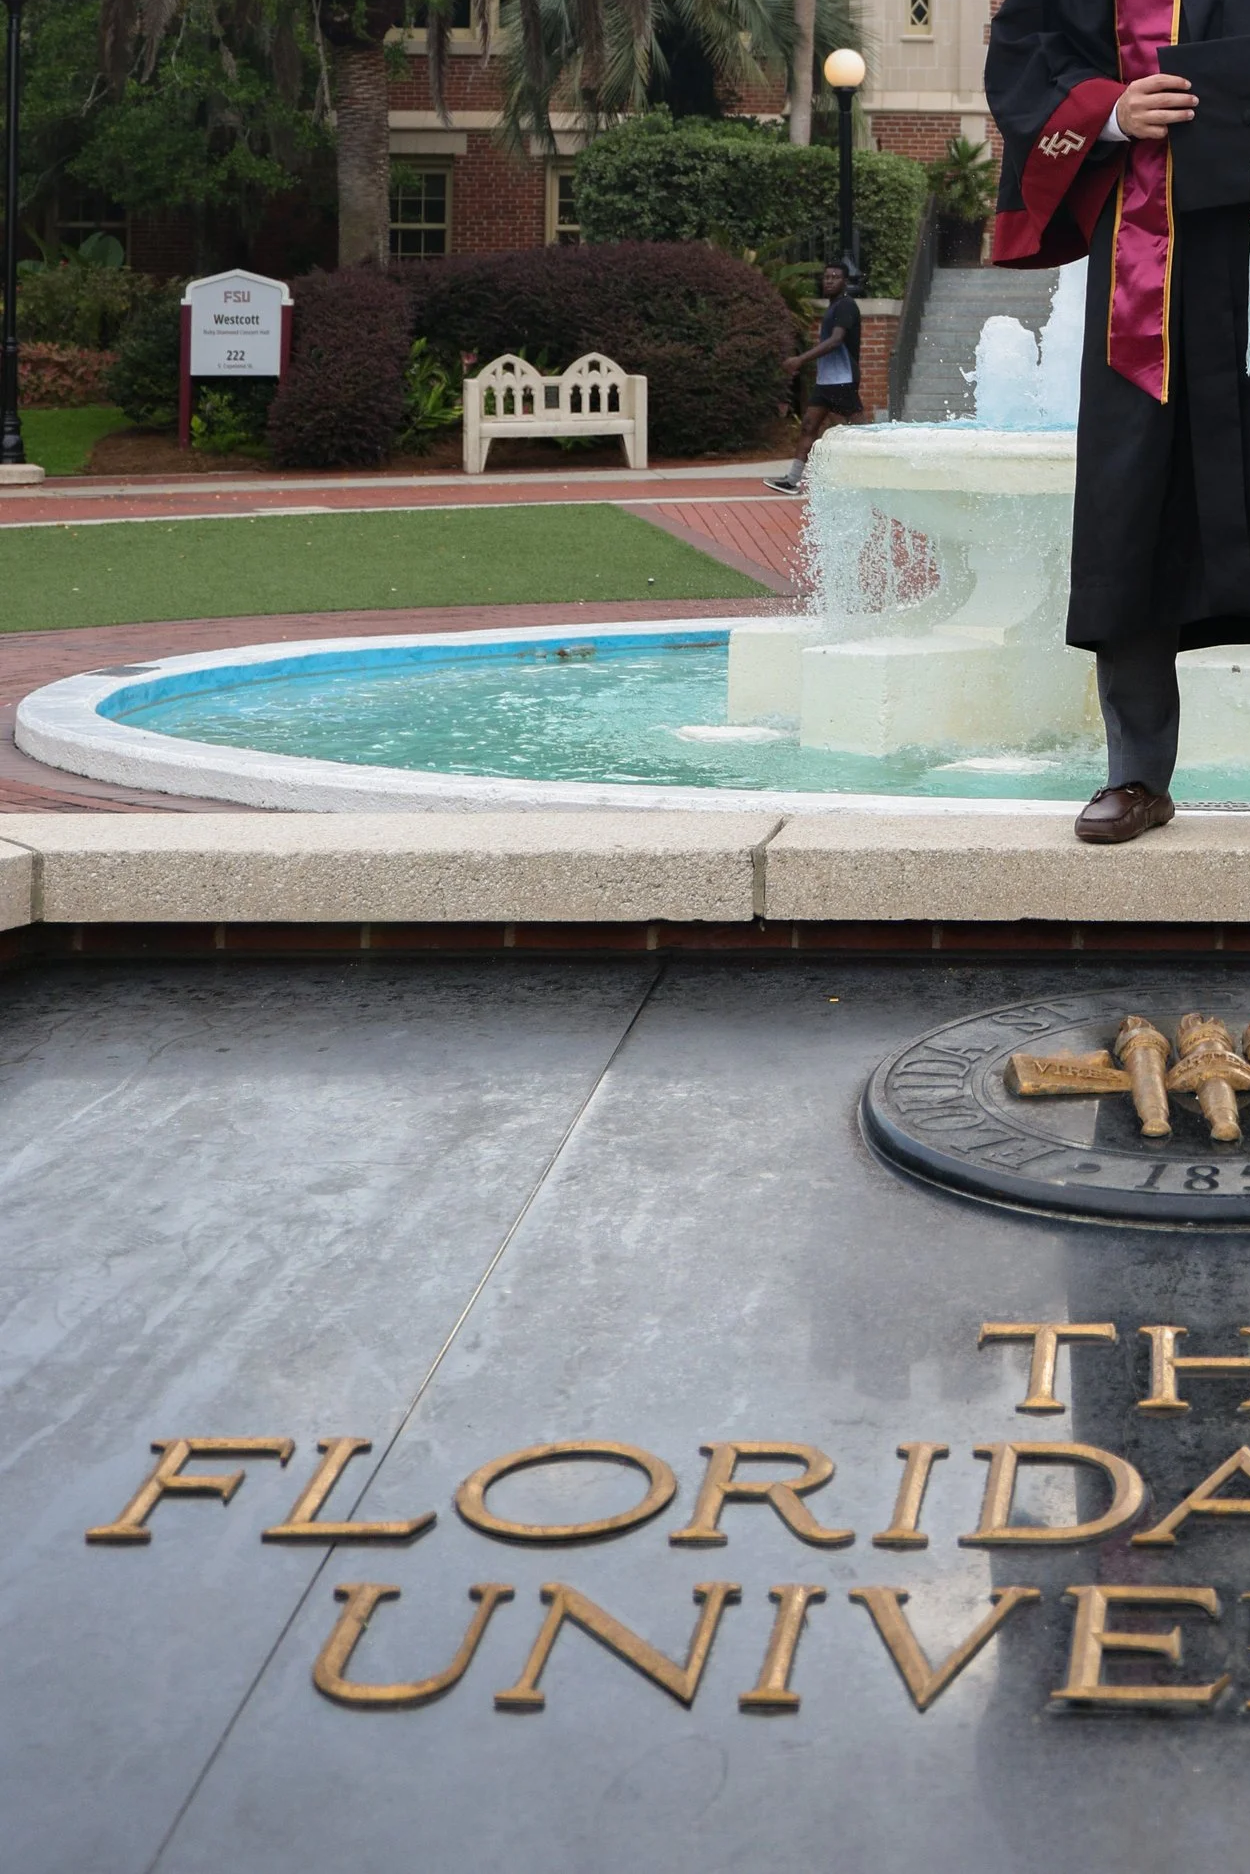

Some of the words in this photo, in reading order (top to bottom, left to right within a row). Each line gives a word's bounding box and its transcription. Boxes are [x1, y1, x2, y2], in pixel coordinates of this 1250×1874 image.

[1038, 129, 1087, 160] FSU
[223, 290, 251, 303] FSU
[213, 313, 260, 326] Westcott
[226, 349, 246, 361] 222
[892, 1043, 1067, 1171] FLORIDA
